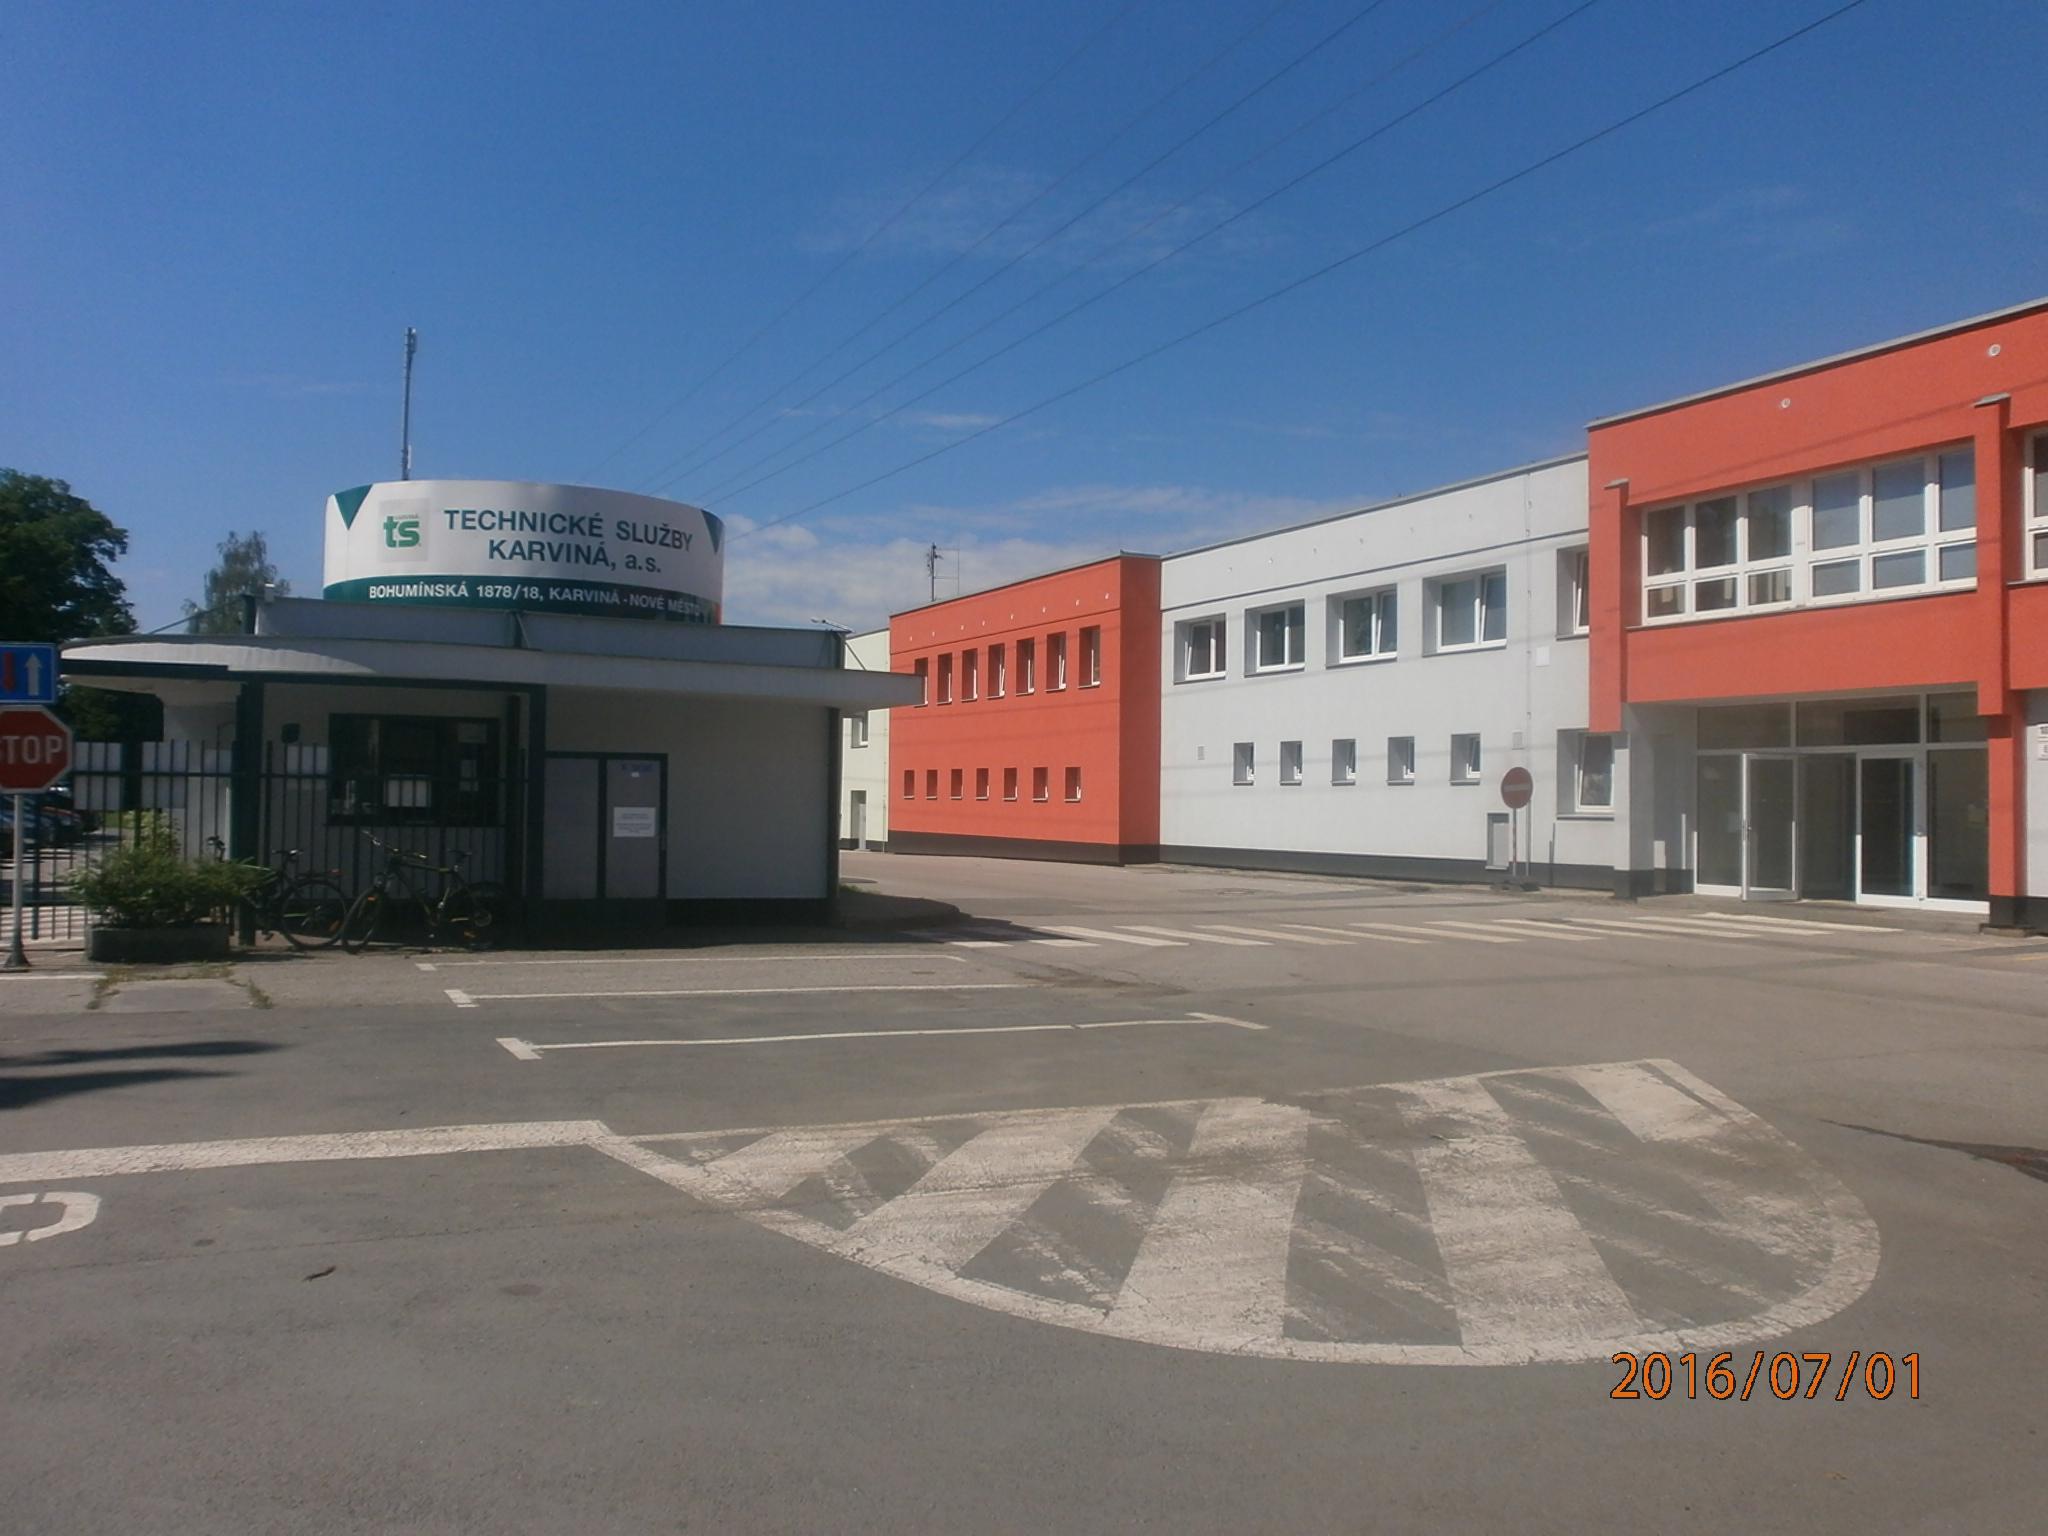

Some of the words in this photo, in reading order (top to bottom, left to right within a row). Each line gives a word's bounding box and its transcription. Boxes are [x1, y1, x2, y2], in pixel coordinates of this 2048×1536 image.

[444, 509, 603, 537] TECHNICKÉ
[616, 520, 693, 551] SLUŽBY
[489, 540, 617, 571] KARVINÁ,
[625, 554, 661, 572] a.s.
[369, 581, 468, 599] BOHUMÍNSKÁ
[477, 584, 543, 602] 1878/18,
[549, 587, 620, 605] KARVINÁ
[629, 593, 665, 610] NOVÉ
[0, 735, 63, 764] TOP
